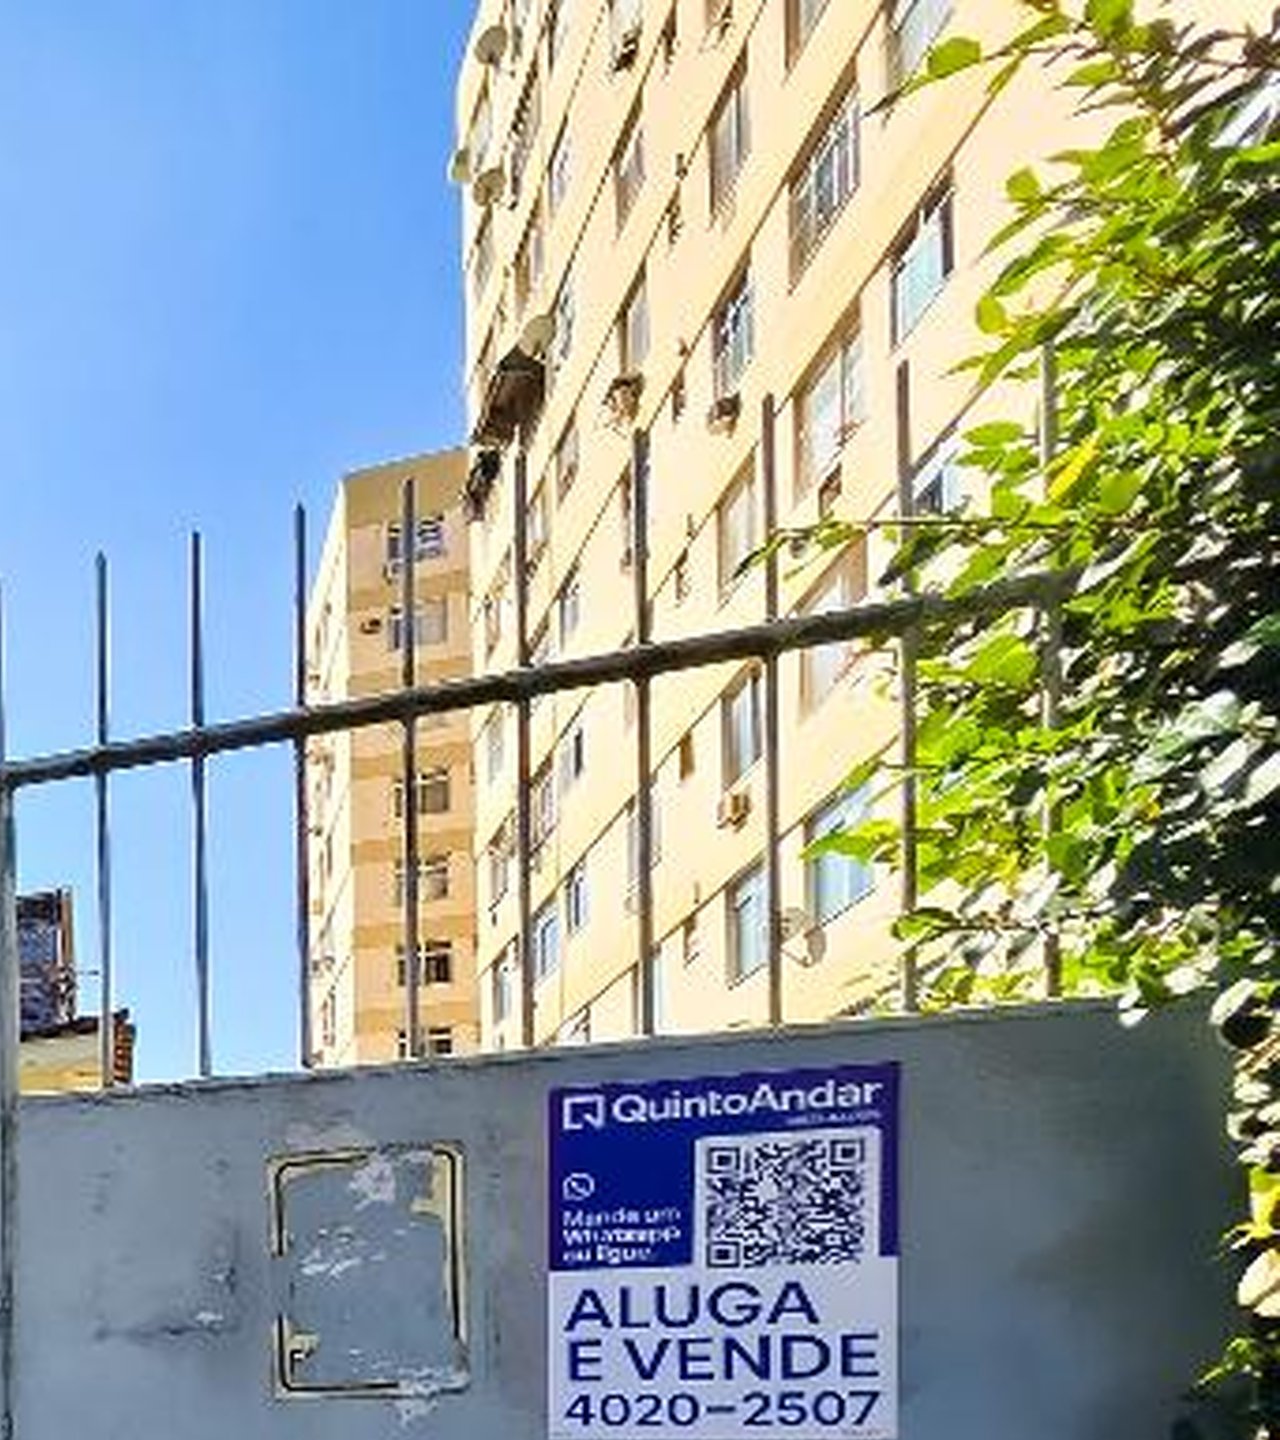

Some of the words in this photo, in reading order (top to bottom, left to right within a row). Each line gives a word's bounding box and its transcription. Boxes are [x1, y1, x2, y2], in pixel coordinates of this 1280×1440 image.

[612, 1079, 883, 1123] QuintoAndar
[564, 1281, 820, 1332] ALUGA
[568, 1338, 602, 1381] E
[623, 1332, 880, 1381] VENDE
[564, 1390, 881, 1427] 4020-2507
